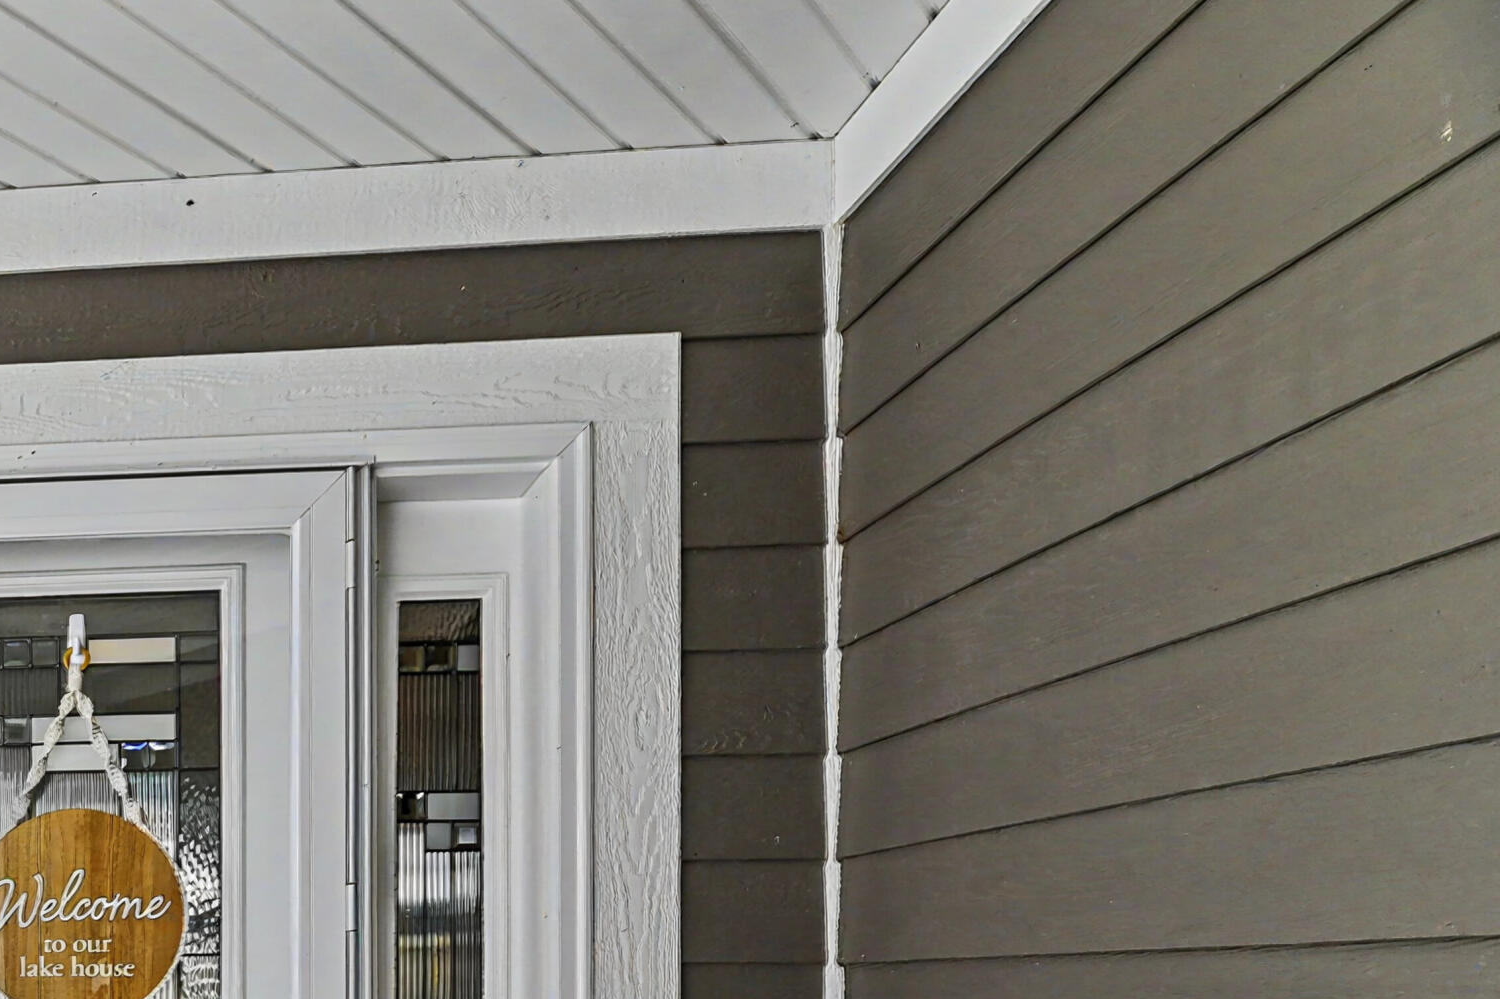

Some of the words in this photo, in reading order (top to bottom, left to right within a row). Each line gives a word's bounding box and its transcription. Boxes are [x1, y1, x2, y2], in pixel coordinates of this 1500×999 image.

[44, 938, 67, 953] to
[72, 938, 112, 953] our
[19, 956, 64, 977] lake
[71, 956, 136, 977] house
